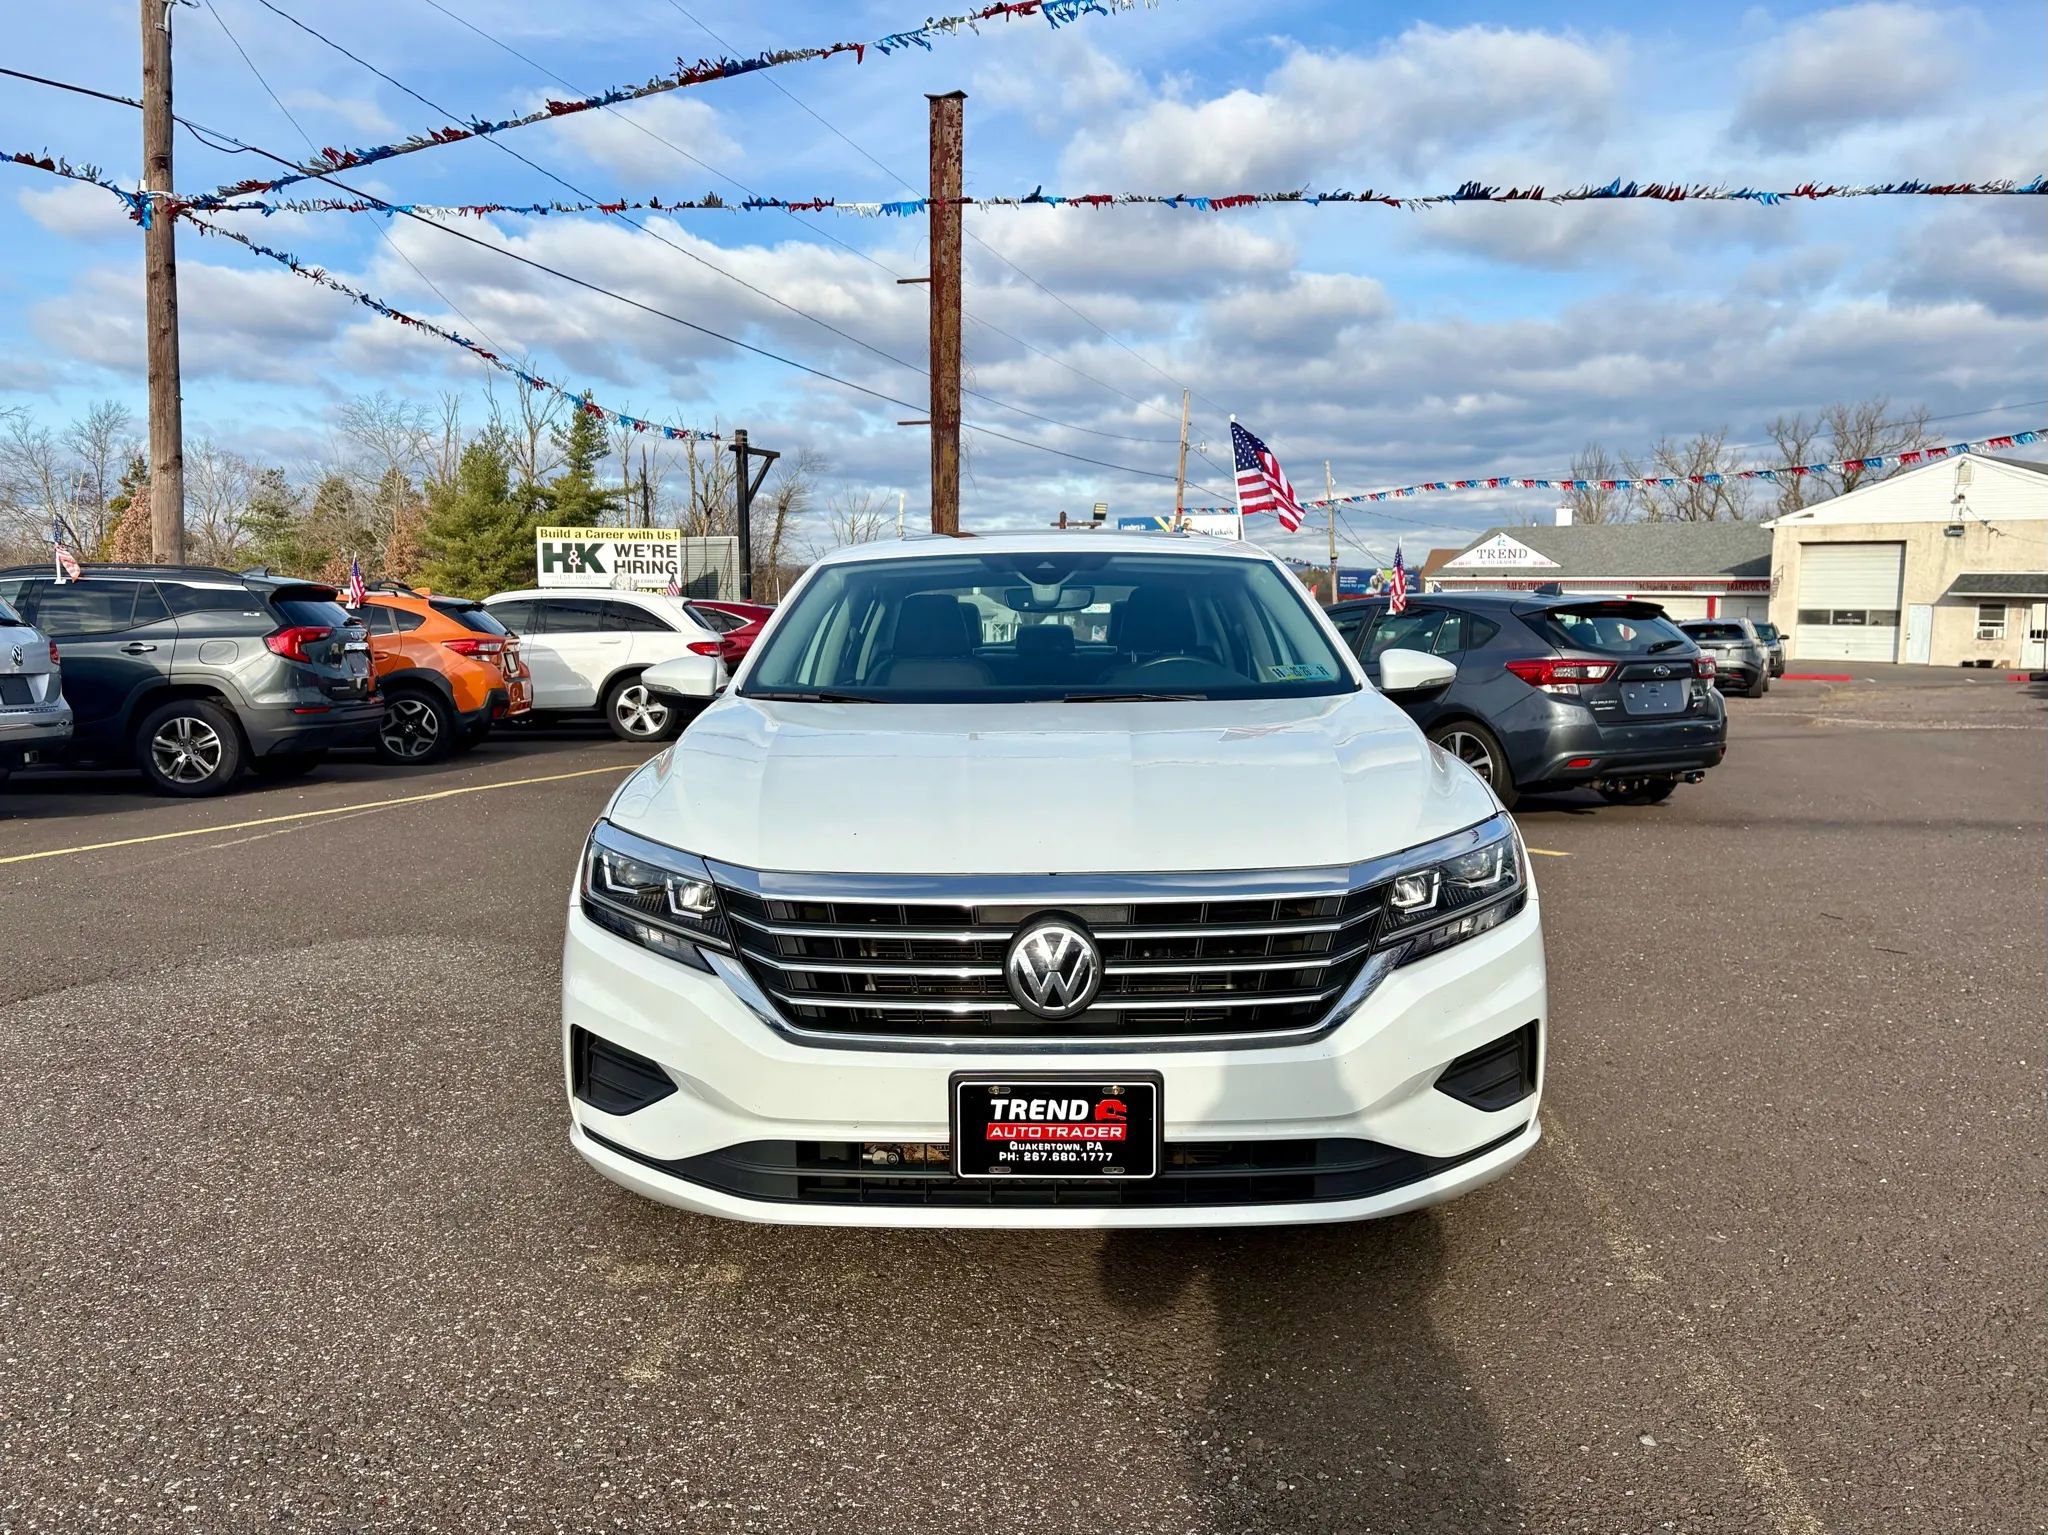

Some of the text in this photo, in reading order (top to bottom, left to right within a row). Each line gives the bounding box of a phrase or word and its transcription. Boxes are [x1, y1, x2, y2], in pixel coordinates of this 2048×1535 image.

[540, 529, 571, 539] Build
[574, 531, 582, 539] a
[585, 529, 625, 540] Career
[628, 530, 654, 540] with
[613, 543, 678, 559] WE'RE
[1477, 549, 1528, 559] TREND
[542, 542, 607, 574] H&K
[613, 560, 678, 575] HIRING
[990, 1098, 1090, 1121] TREND
[990, 1126, 1123, 1138] AUTO TRADER
[1086, 1141, 1103, 1151] PA
[999, 1152, 1113, 1162] PH: 267.680.1777
